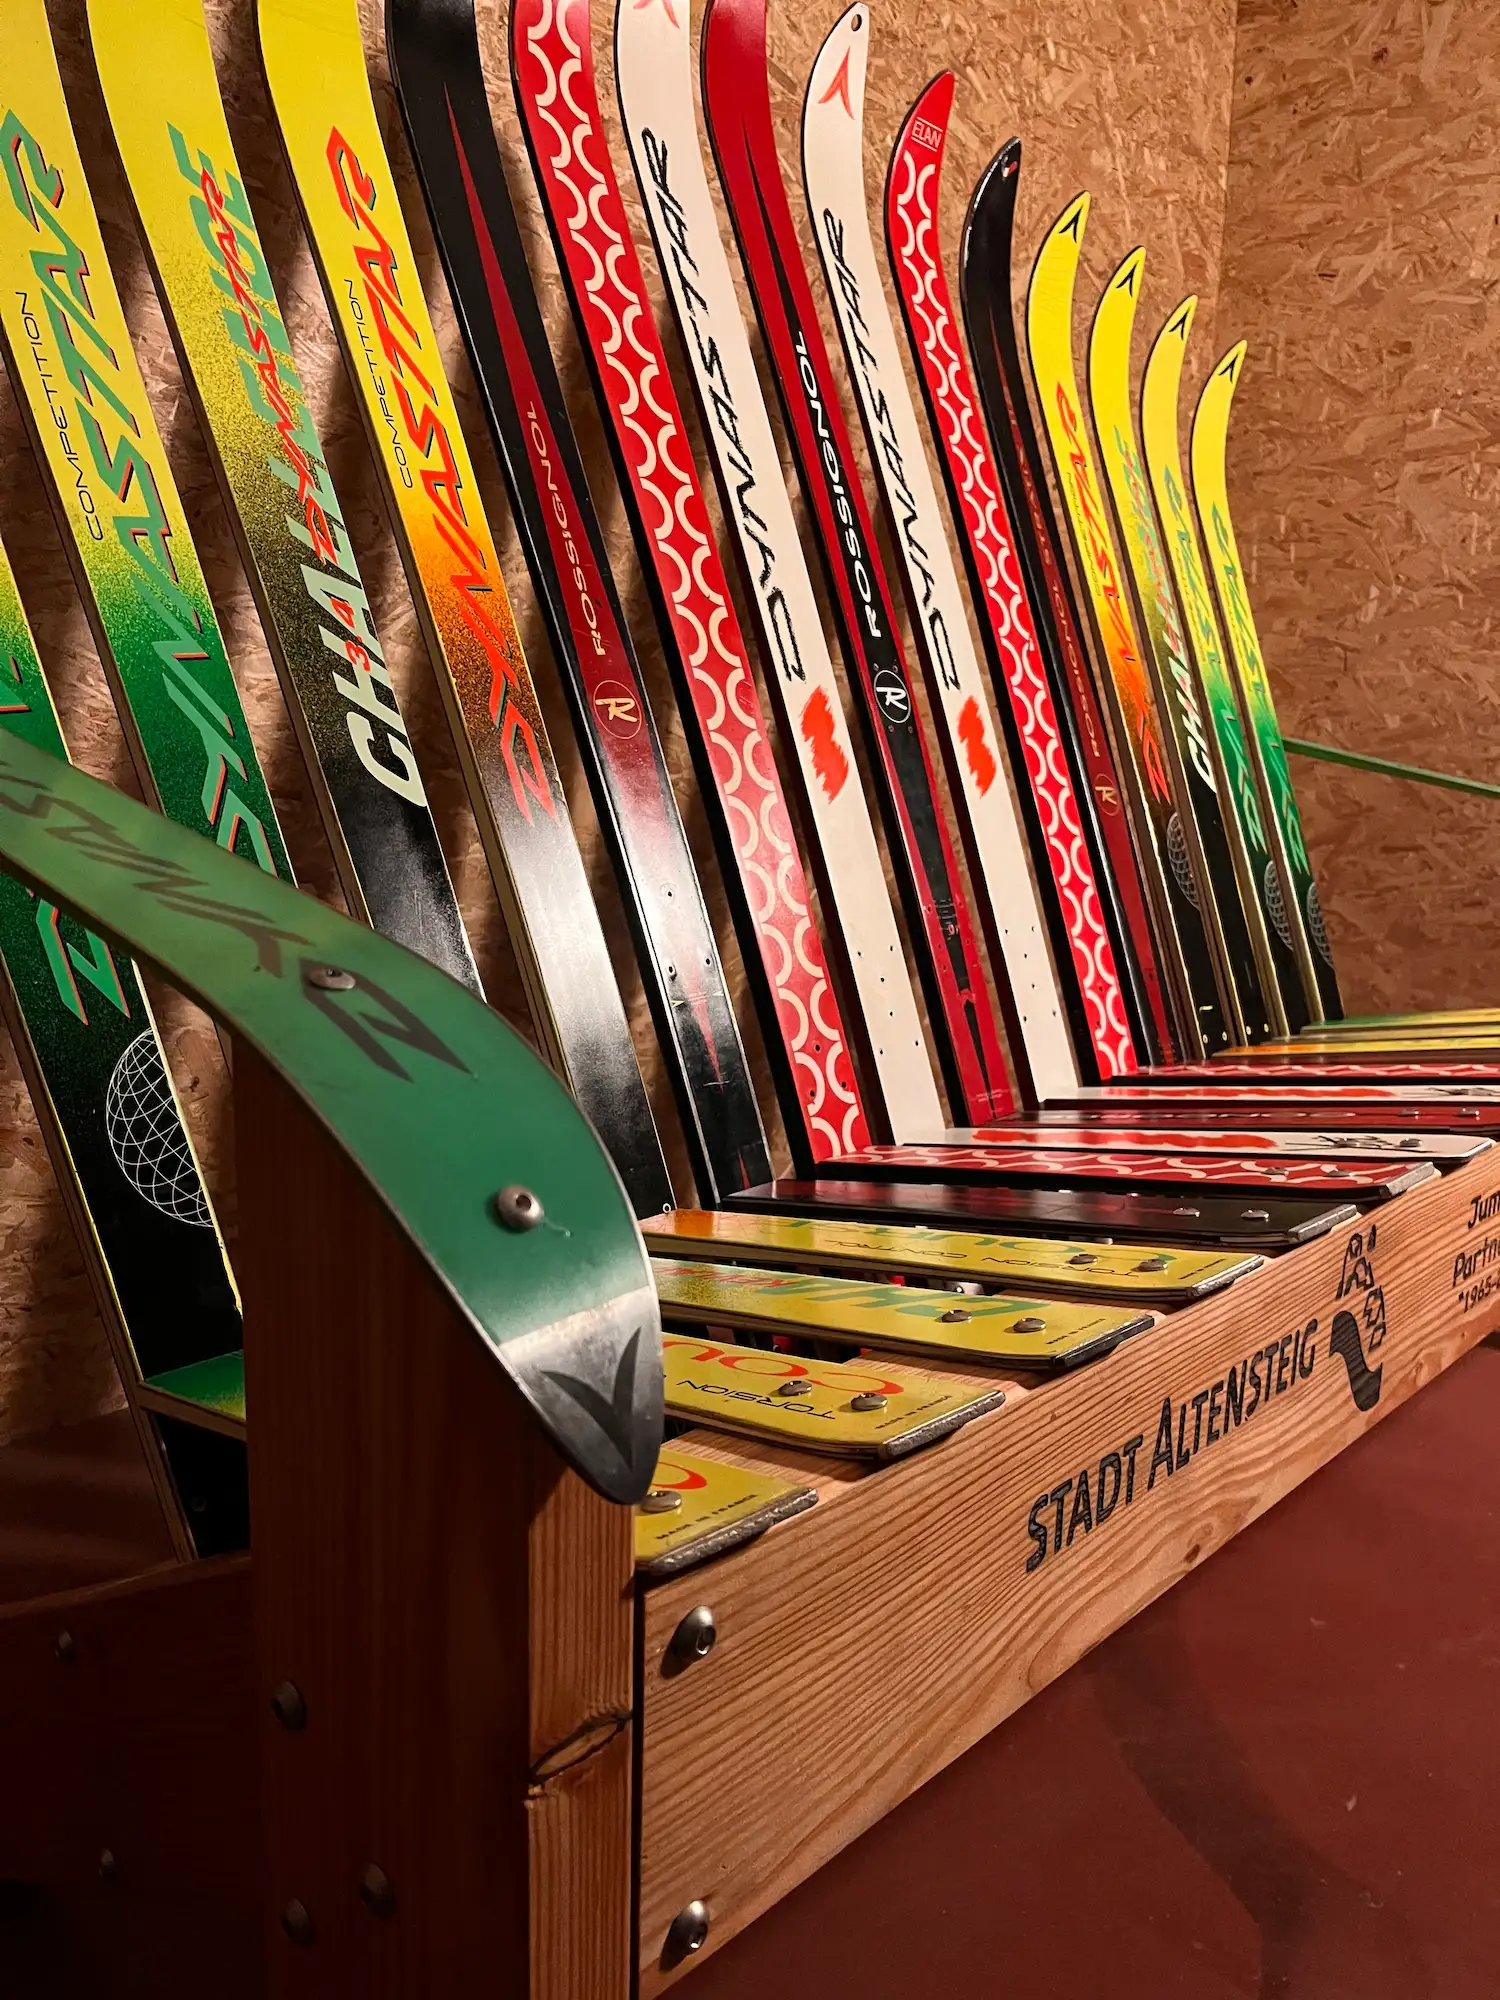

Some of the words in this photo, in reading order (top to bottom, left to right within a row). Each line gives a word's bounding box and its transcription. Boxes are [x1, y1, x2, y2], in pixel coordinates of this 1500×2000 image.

[912, 120, 942, 148] ELAN
[0, 109, 278, 878] DYNASTAR
[15, 291, 102, 541] COMPETITION
[201, 167, 338, 566] DYNASTAR
[326, 125, 559, 827] DYNASTAR
[344, 279, 413, 489] COMPETITION
[641, 127, 807, 684] DYNASTAR
[797, 331, 882, 638] ROSSIGNOL
[823, 208, 961, 692] DYNASTAR
[528, 402, 606, 656] ROSSIGNOL
[1051, 583, 1100, 758] ROSSIGNOL
[0, 762, 476, 1083] DYNAS
[823, 1239, 968, 1259] CONTROL
[981, 1256, 1140, 1279] TORSION
[1467, 1190, 1500, 1229] Jum
[676, 1379, 836, 1420] TORSION
[1025, 1433, 1144, 1573] STADT
[1147, 1318, 1318, 1491] ALTENSTEIG
